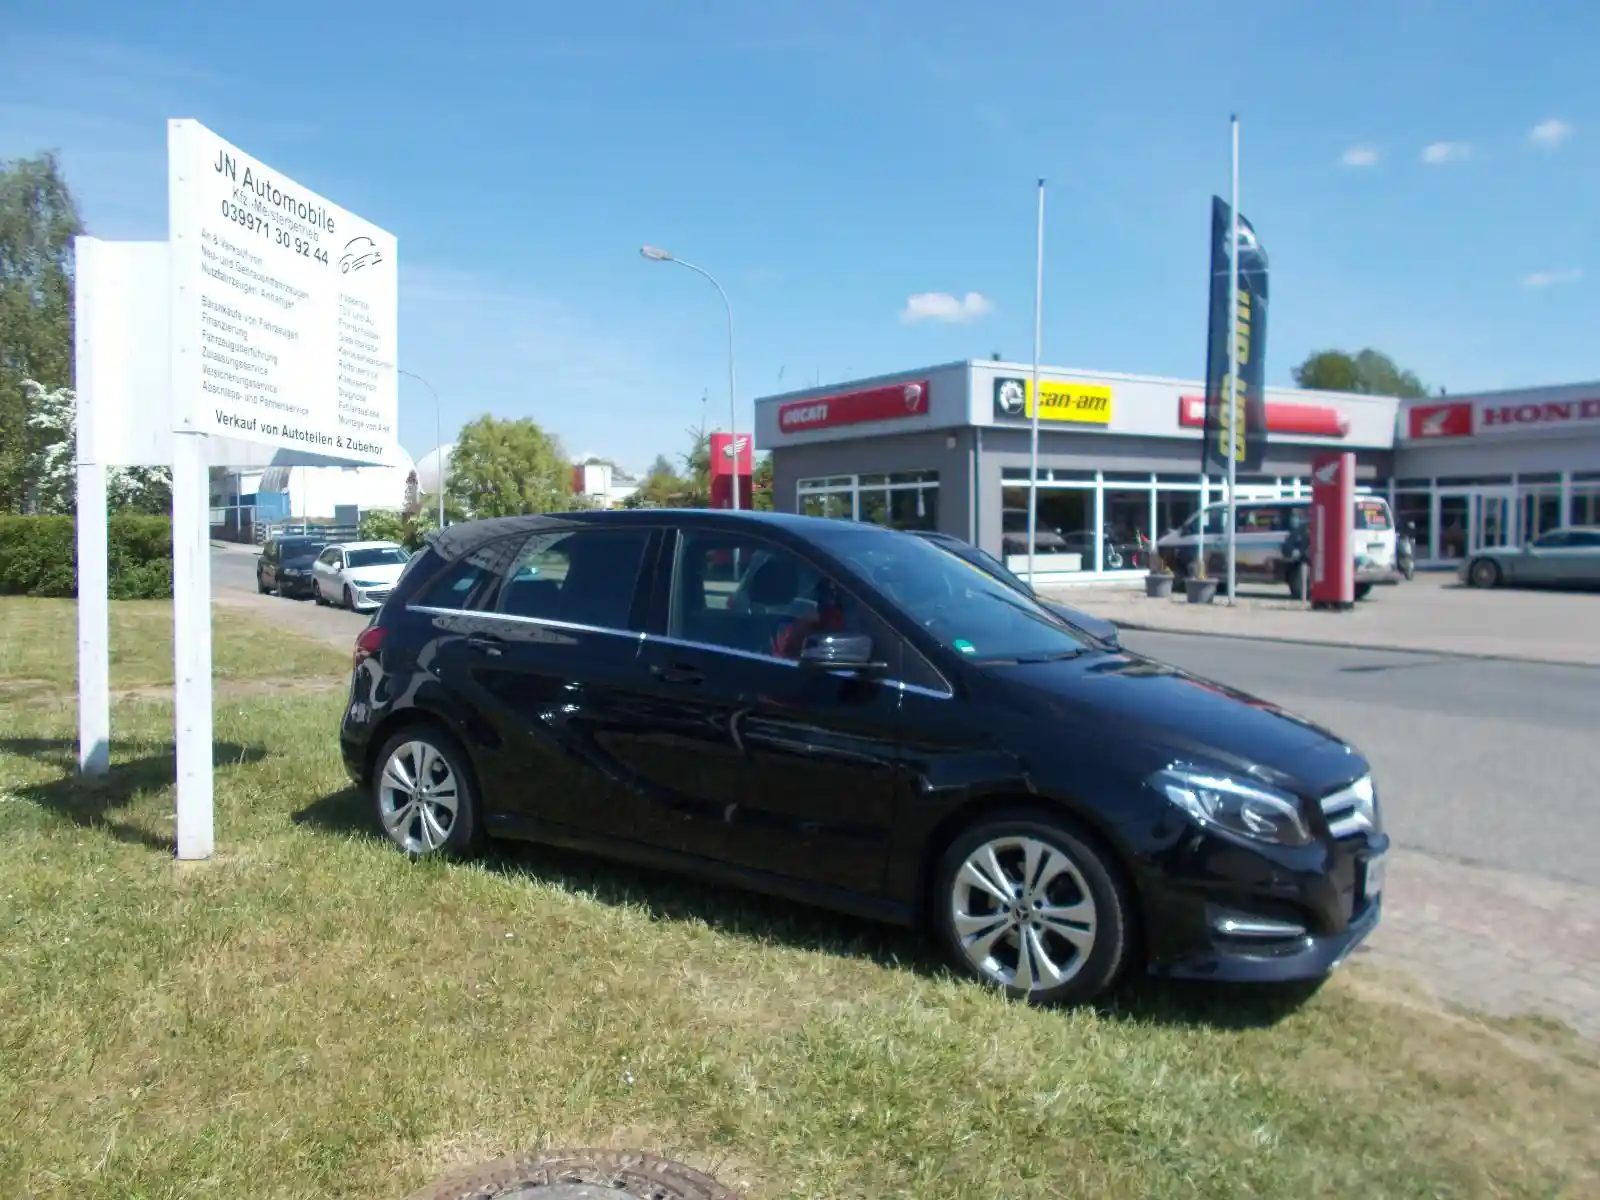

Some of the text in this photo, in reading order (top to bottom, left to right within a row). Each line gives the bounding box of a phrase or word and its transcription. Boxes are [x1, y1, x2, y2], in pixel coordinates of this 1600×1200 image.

[214, 150, 335, 234] JN Automobile
[222, 199, 328, 266] 039971 30 92 44
[1036, 390, 1107, 412] can-am
[215, 409, 257, 431] Verkauf
[260, 423, 279, 436] von
[281, 425, 333, 446] Autoteilen
[336, 436, 343, 448] &
